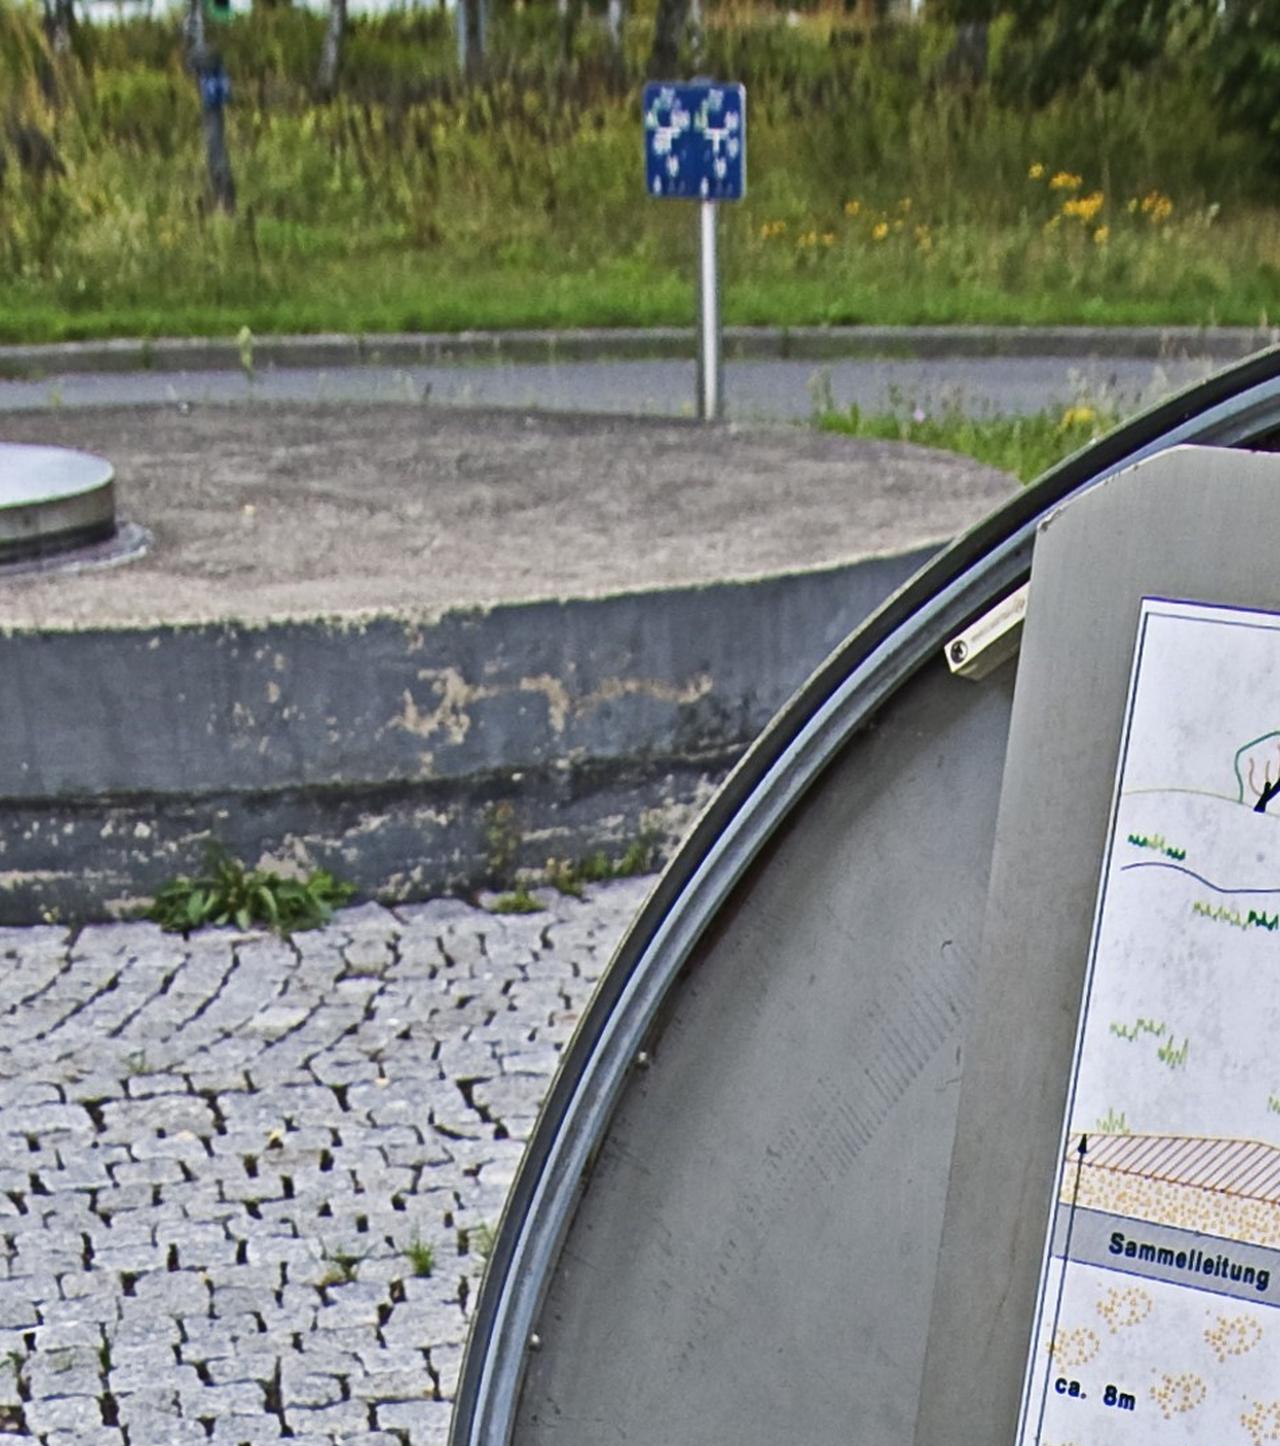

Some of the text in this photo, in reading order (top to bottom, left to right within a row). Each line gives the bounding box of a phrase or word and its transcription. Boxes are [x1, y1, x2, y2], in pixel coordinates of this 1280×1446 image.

[1109, 1233, 1271, 1291] Sammelleitung
[1055, 1377, 1135, 1411] ca. 8m
